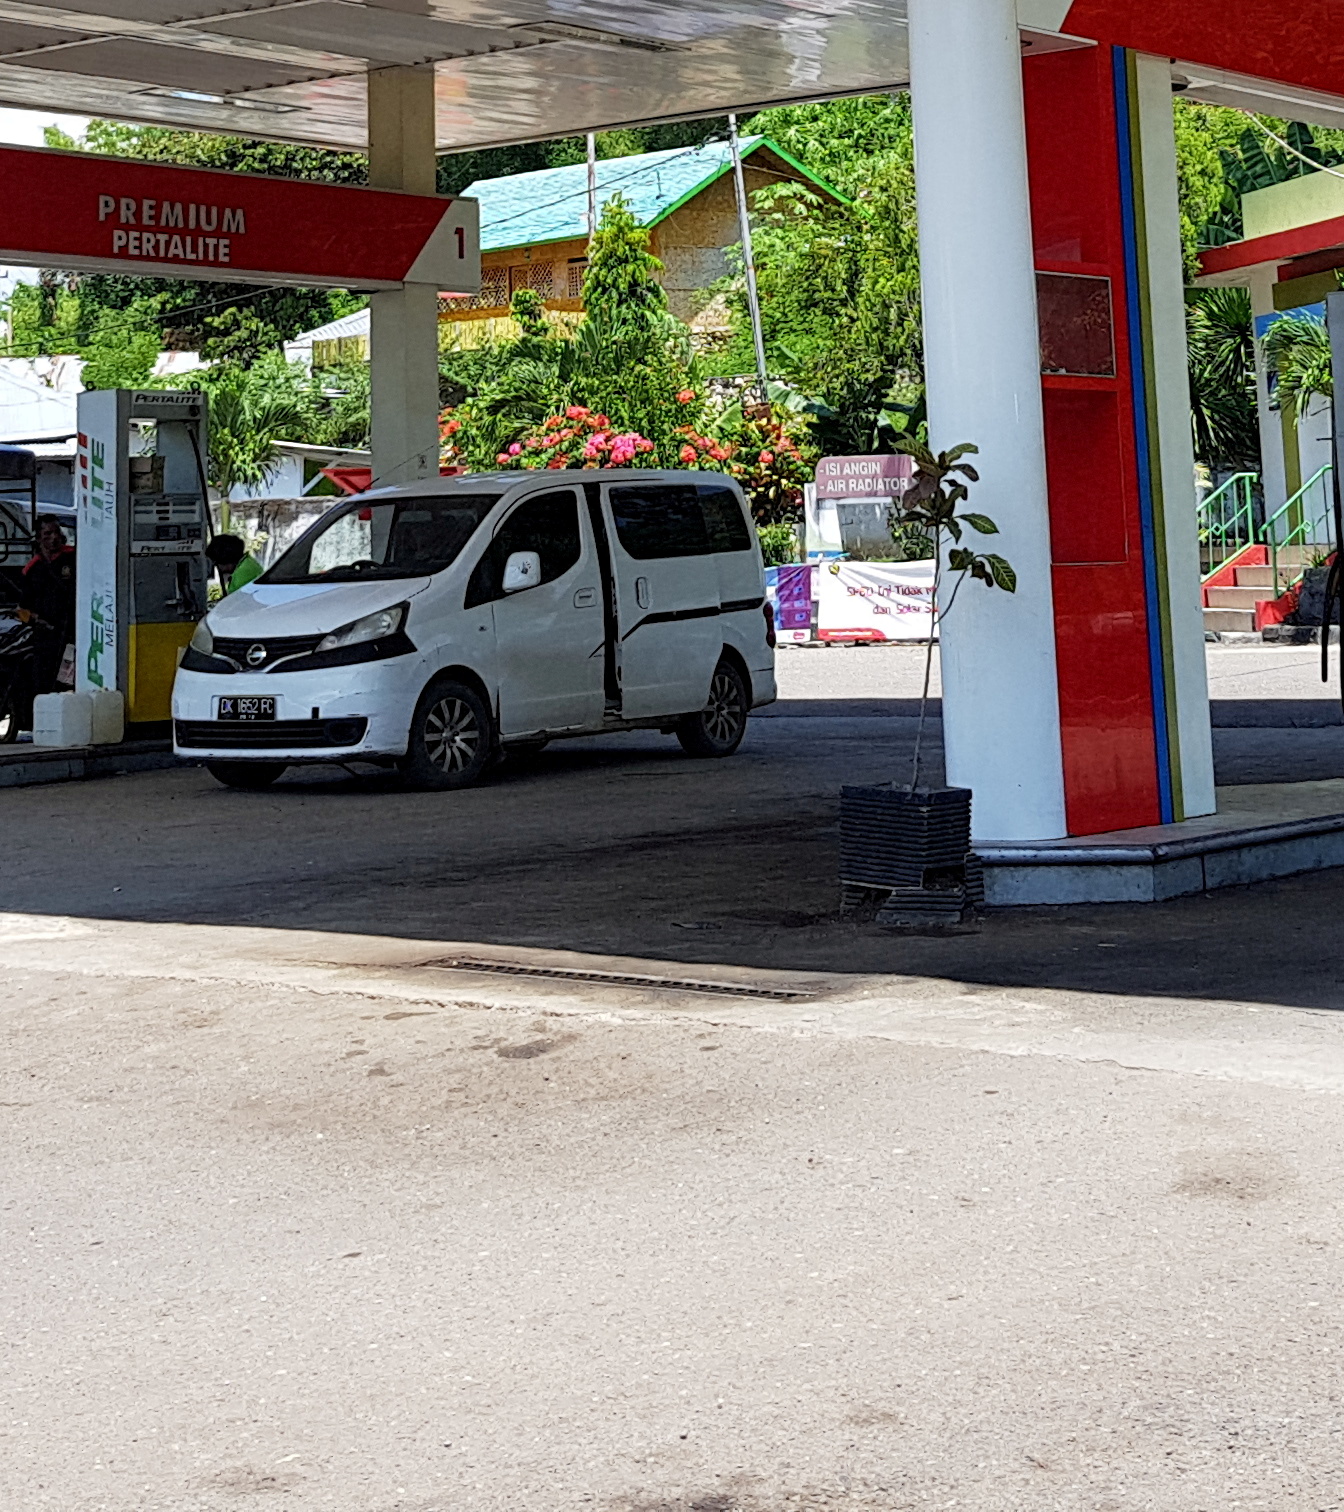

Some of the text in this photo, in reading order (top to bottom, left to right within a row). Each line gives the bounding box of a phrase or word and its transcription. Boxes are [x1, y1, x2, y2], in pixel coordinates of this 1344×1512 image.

[98, 194, 246, 234] PREMIUM
[112, 229, 230, 263] PERTALITE
[454, 226, 464, 259] 1
[843, 462, 881, 476] ANGIN
[826, 479, 846, 493] AIR
[848, 477, 908, 492] RADIATOR
[237, 698, 259, 714] 1652
